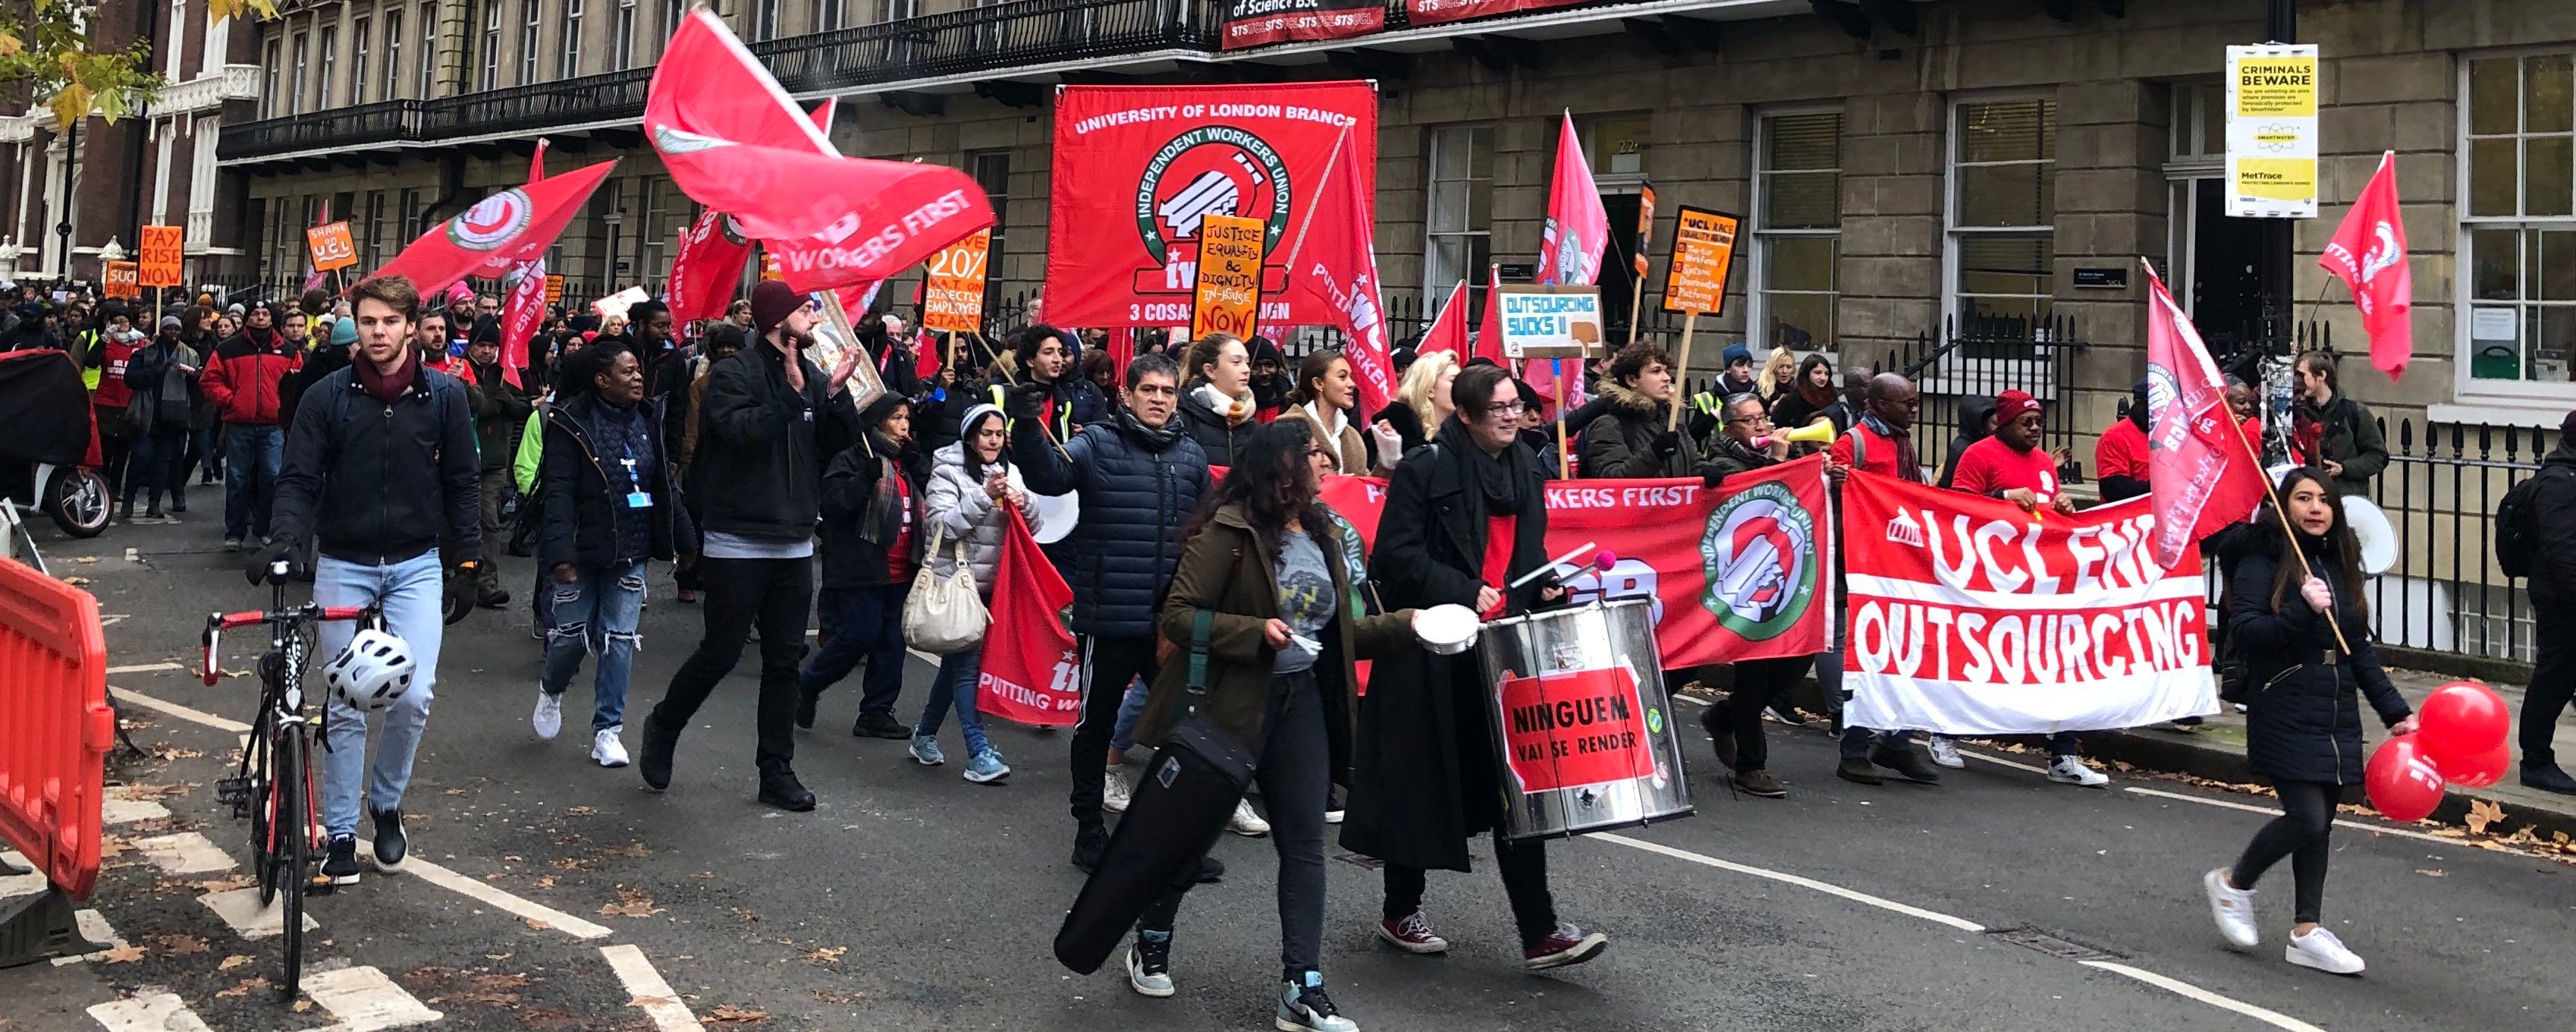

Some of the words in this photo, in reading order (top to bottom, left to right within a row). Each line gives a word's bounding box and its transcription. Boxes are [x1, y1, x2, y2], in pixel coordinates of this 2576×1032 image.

[2241, 65, 2311, 74] CRIMINALS
[2241, 74, 2311, 86] BEWARE
[1074, 105, 1178, 135] UNIVERSITY
[1186, 104, 1205, 118] OF
[1210, 104, 1281, 118] LONDON
[1285, 105, 1357, 127] BRANC
[1138, 129, 1204, 219] INDEPENDENT
[1206, 127, 1279, 167] WORKERS
[1271, 166, 1289, 214] UNION
[2241, 171, 2282, 180] MetTrace
[901, 188, 971, 237] FIRST
[143, 228, 181, 247] PAY
[310, 224, 347, 239] SHAME
[142, 247, 181, 264] RISE
[313, 240, 350, 256] UCL
[1207, 242, 1259, 260] EQUALITY
[930, 247, 986, 281] 20%
[140, 268, 181, 285] NOW
[967, 282, 983, 292] ON
[925, 299, 982, 315] EMPLOYED
[1129, 303, 1140, 321] 3
[1506, 296, 1594, 314] OUTSOURCING
[1196, 304, 1254, 337] NOW
[1507, 316, 1554, 335] SUCKS
[1622, 485, 1701, 507] FIRST
[1700, 489, 1753, 571] INDEPENDENT
[1921, 509, 2061, 596] UCL
[1854, 599, 2201, 684] OUTSOURCING
[978, 672, 1051, 710] PUTTING
[1513, 694, 1631, 735] NINGUEM
[1516, 743, 1544, 763] VAI
[1549, 740, 1569, 759] SE
[1577, 731, 1638, 755] RENDER
